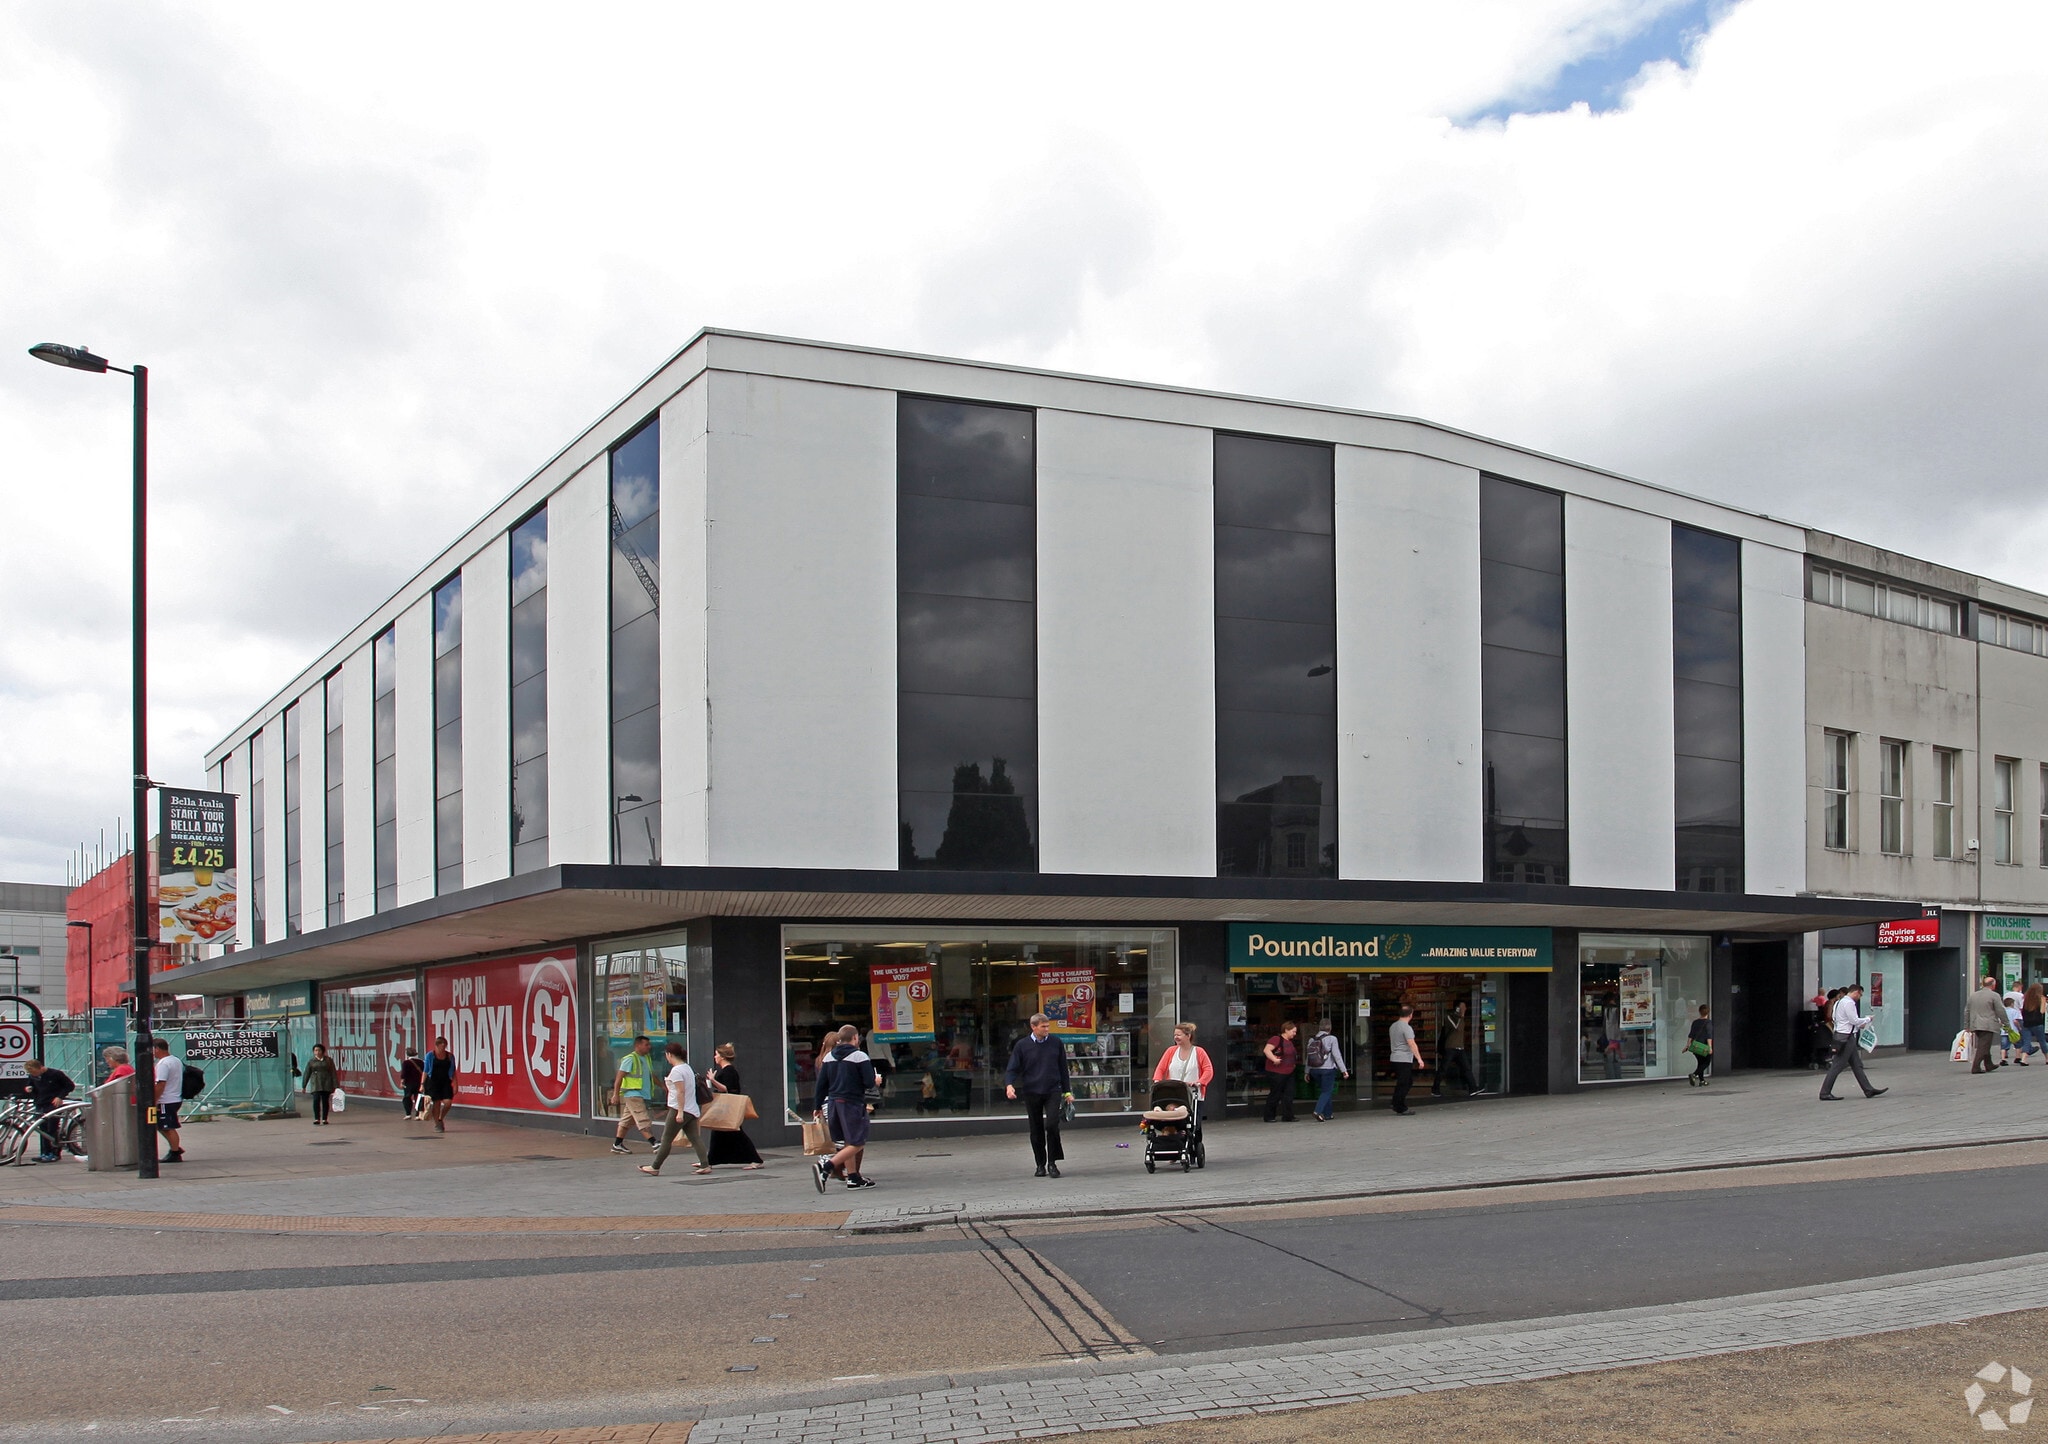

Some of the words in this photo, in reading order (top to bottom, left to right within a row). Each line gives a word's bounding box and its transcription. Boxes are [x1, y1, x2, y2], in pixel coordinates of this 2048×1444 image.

[171, 795, 196, 806] Bella
[198, 798, 224, 809] Italia
[170, 808, 198, 820] START
[201, 810, 225, 822] YOUR
[170, 819, 201, 832] BELLA
[204, 821, 225, 834] DAY
[170, 833, 225, 842] BREAKFAST
[172, 846, 224, 867] £4.25
[1926, 909, 1938, 917] JLL
[1985, 916, 2031, 928] YORKSHIRE
[1879, 928, 1916, 937] Enquiries
[1894, 935, 1914, 943] 7399
[1915, 934, 1936, 942] 5555
[1985, 929, 2024, 941] BUILDING
[1248, 933, 1379, 957] Poundland
[1469, 947, 1495, 957] VALUE
[1496, 948, 1537, 957] EVERYDAY
[452, 977, 472, 1007] POP
[474, 975, 487, 1005] IN
[911, 984, 927, 997] £1
[1075, 987, 1091, 1000] £1
[325, 992, 377, 1048] VALUE
[185, 1031, 234, 1040] BARGATE
[238, 1030, 278, 1039] STREET
[431, 1005, 514, 1075] TODAY!
[531, 988, 569, 1084] £1
[197, 1038, 263, 1048] BUSINESSES
[186, 1048, 217, 1057] OPEN
[218, 1047, 233, 1055] AS
[235, 1046, 271, 1055] USUAL
[340, 1049, 353, 1072] CAN
[353, 1049, 377, 1073] TRUST!
